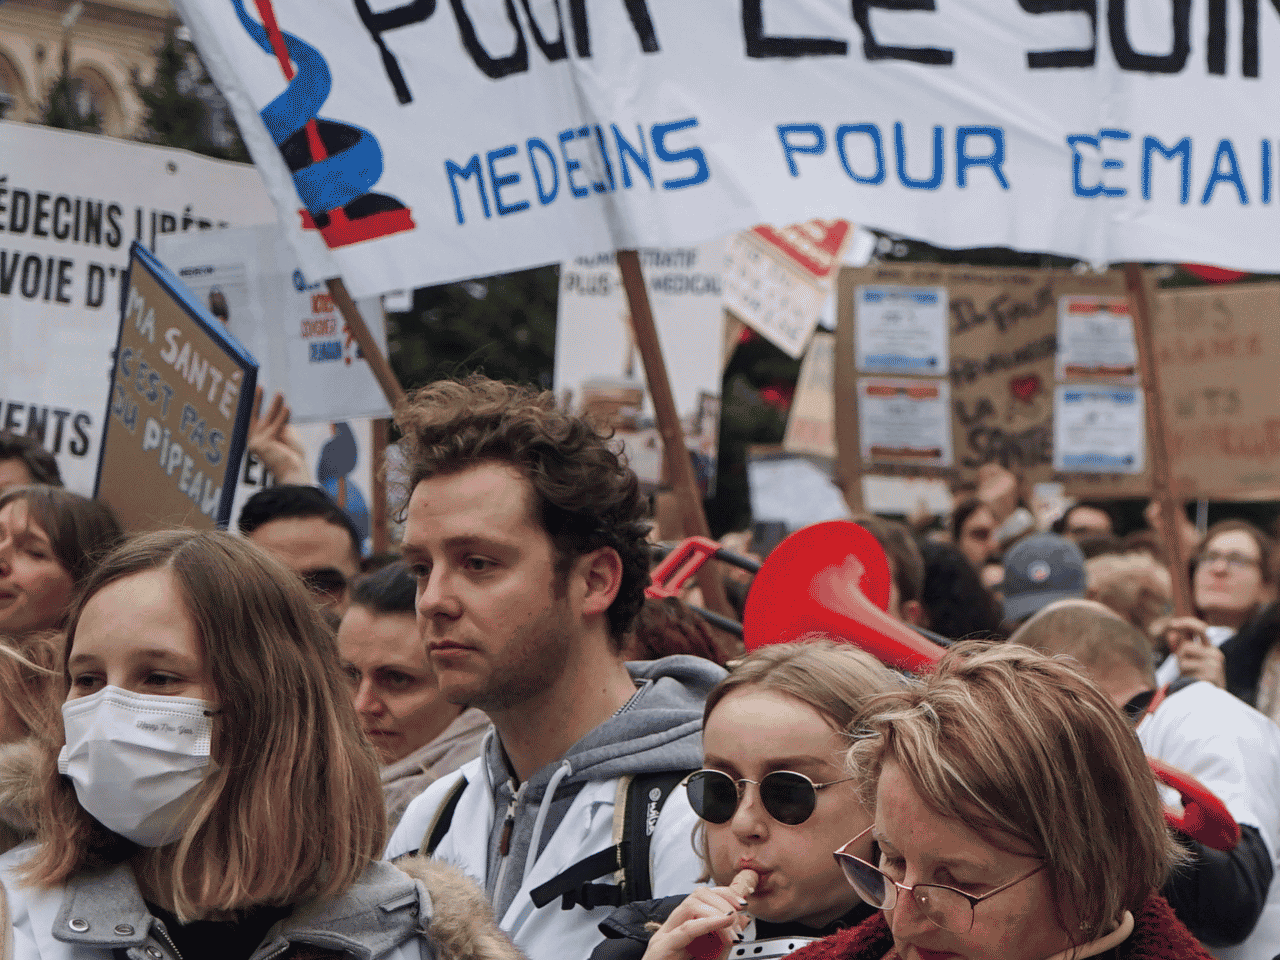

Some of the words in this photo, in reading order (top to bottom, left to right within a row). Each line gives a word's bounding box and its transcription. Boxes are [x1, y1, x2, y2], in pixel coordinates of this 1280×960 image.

[776, 121, 1010, 191] POUR
[125, 286, 156, 344] MA
[160, 326, 245, 420] SANTÉ
[179, 403, 226, 467] PAS
